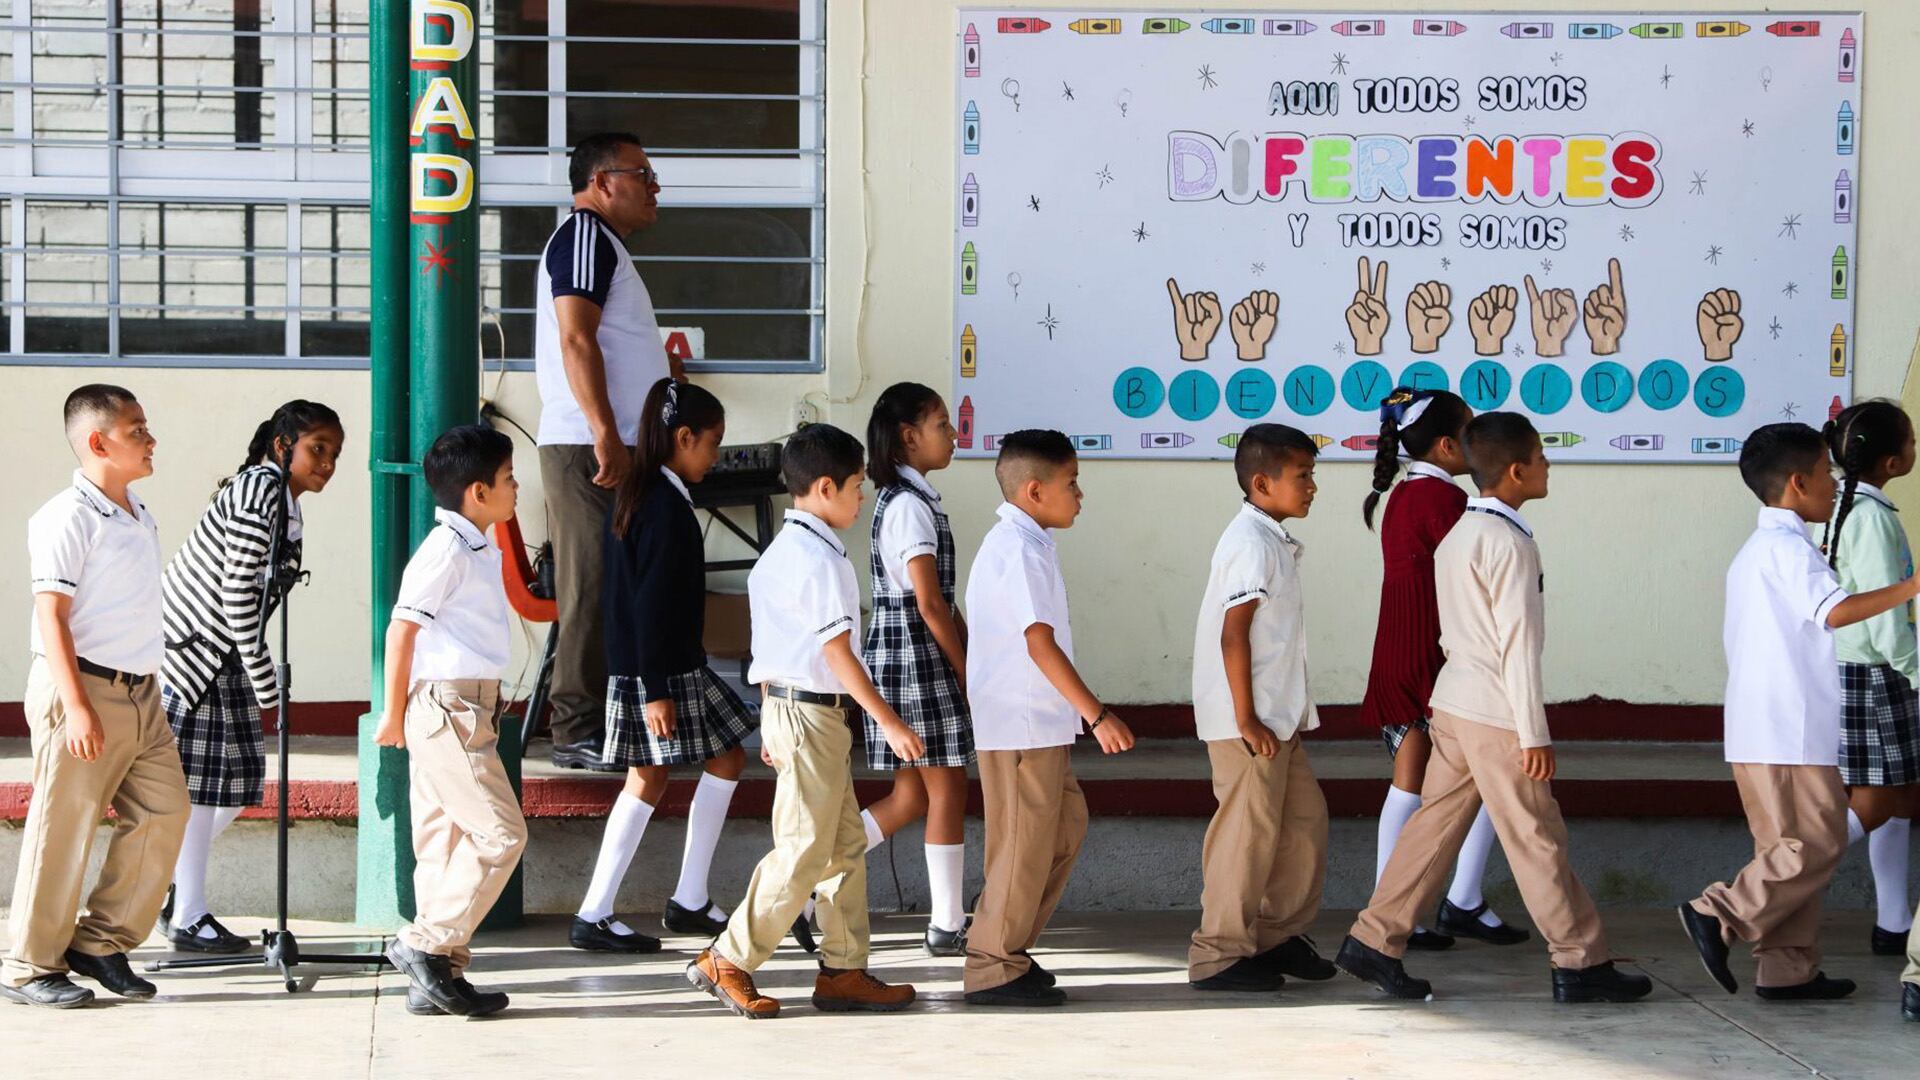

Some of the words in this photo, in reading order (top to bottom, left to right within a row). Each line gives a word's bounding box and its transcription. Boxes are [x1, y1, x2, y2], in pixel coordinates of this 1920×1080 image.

[411, 0, 476, 213] DAD
[1269, 81, 1340, 116] AQUI
[1354, 76, 1460, 113] TODOS
[1478, 75, 1587, 112] SOMOS
[1171, 136, 1657, 201] DIFERENTES
[1287, 212, 1309, 248] Y
[1337, 212, 1442, 248] TODOS
[1459, 214, 1568, 250] SOMOS
